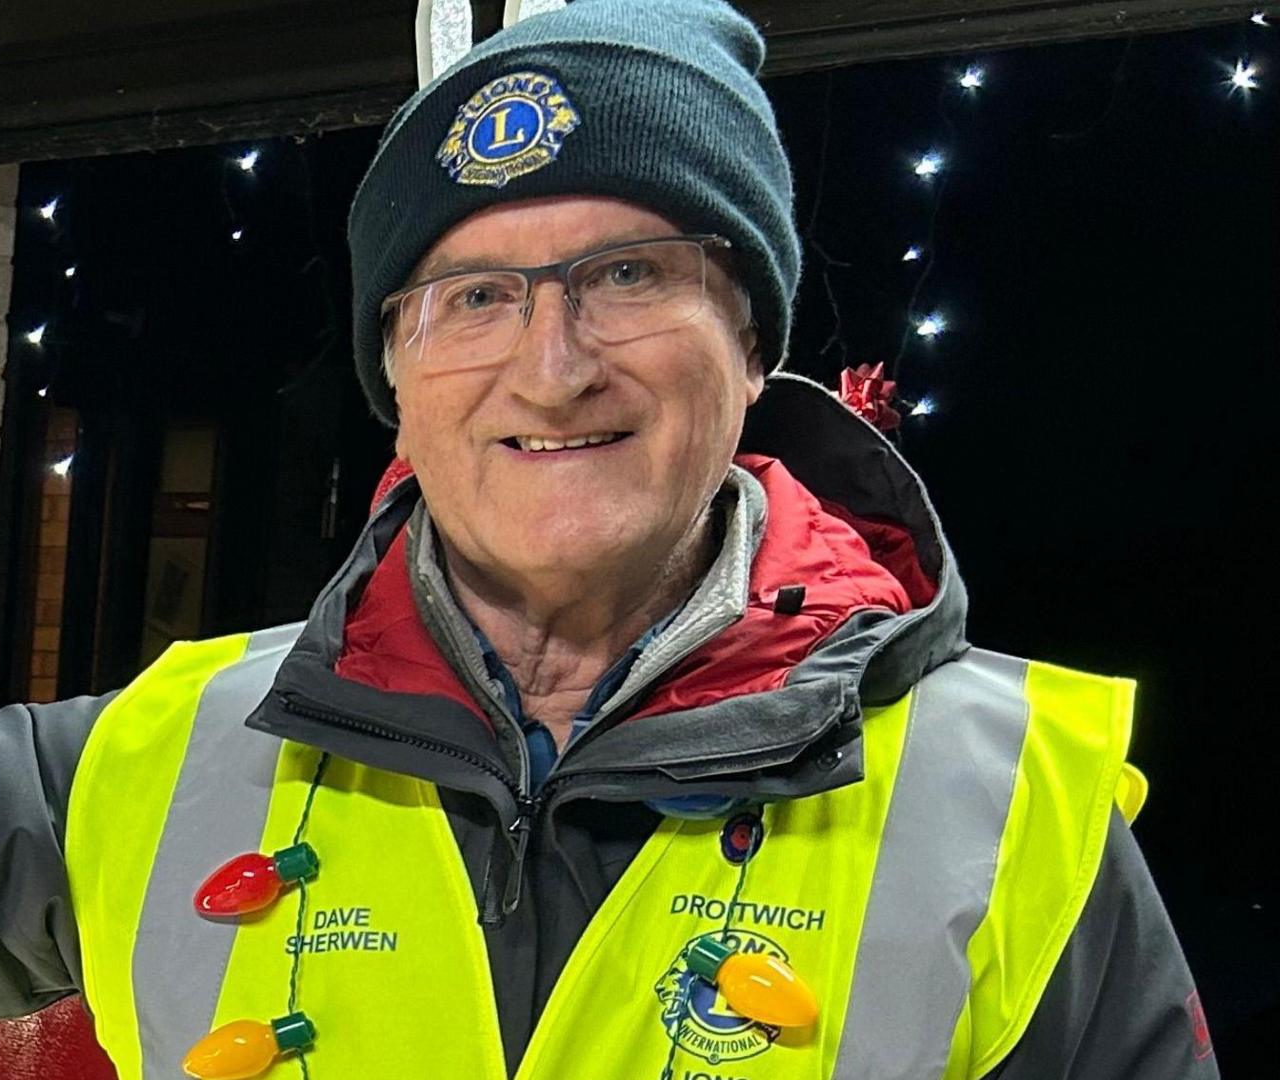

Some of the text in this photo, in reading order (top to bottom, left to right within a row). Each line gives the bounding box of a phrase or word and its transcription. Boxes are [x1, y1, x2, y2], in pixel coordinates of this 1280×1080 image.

[467, 78, 547, 113] LIONS
[487, 107, 525, 150] L
[313, 907, 371, 930] DAVE
[670, 894, 826, 931] DROTWICH
[285, 931, 398, 955] SHERWEN
